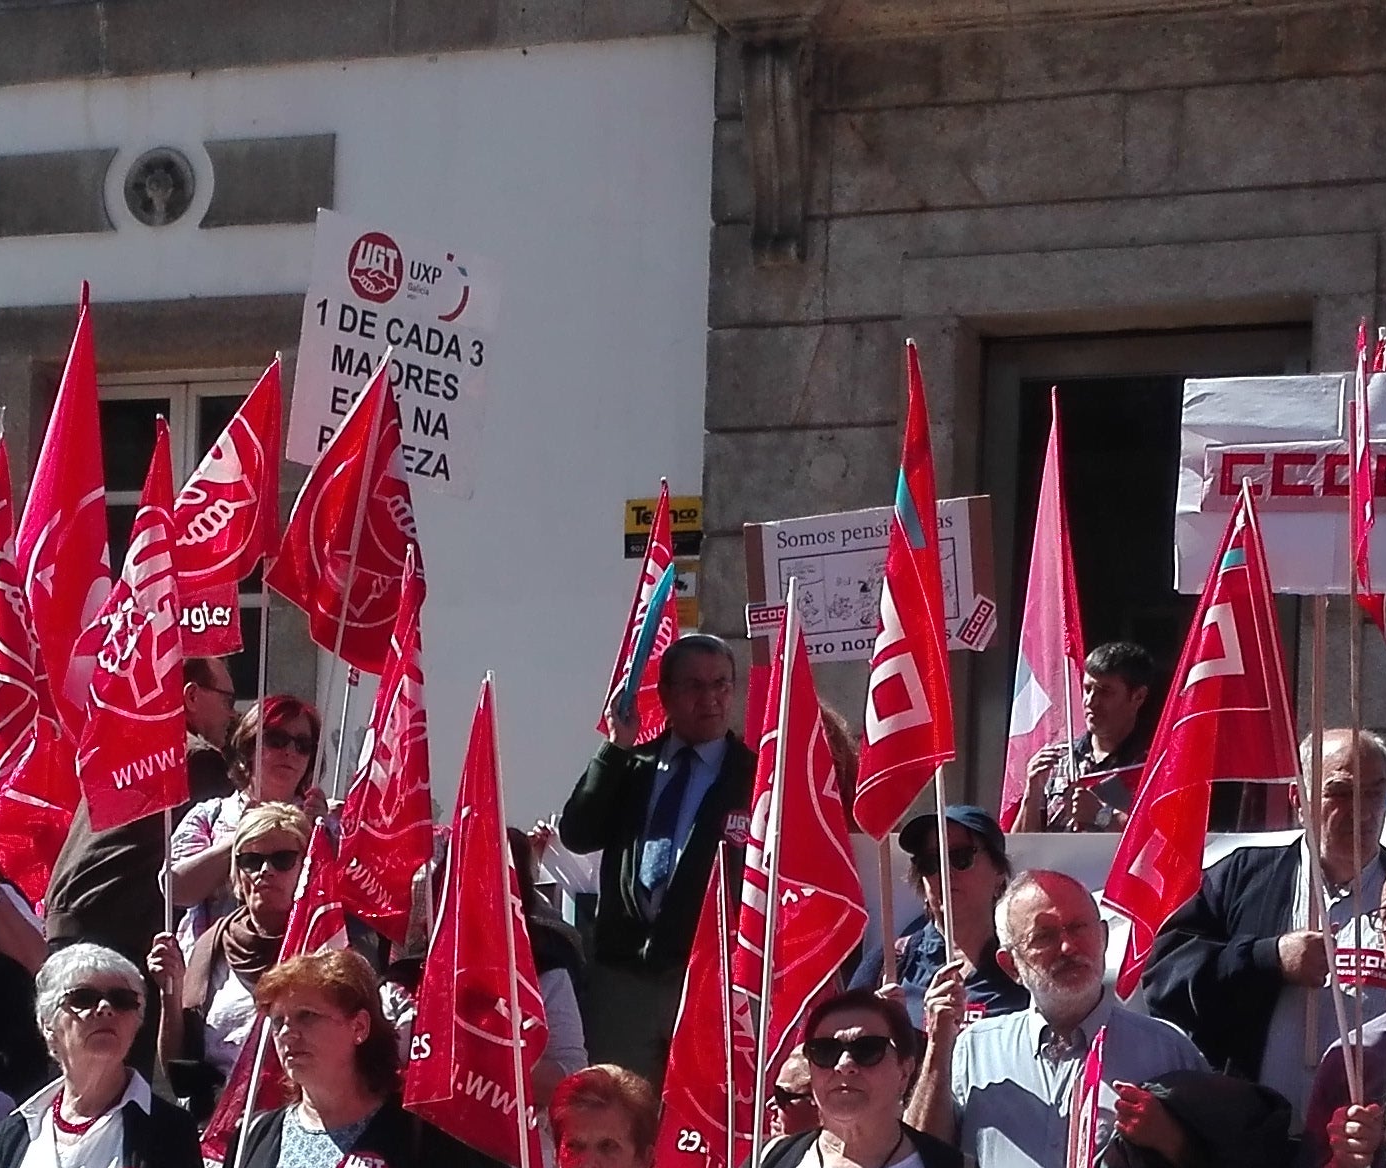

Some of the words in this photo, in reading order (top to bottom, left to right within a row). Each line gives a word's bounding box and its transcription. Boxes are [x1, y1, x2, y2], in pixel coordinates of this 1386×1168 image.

[355, 240, 399, 278] UGT
[410, 261, 442, 285] UXP
[316, 299, 328, 326] 1
[339, 304, 376, 340] DE
[386, 318, 462, 362] CADA
[469, 340, 484, 367] 3
[413, 406, 450, 440] NA
[777, 528, 835, 549] Somos
[963, 602, 993, 643] CCOO
[805, 638, 835, 656] ero
